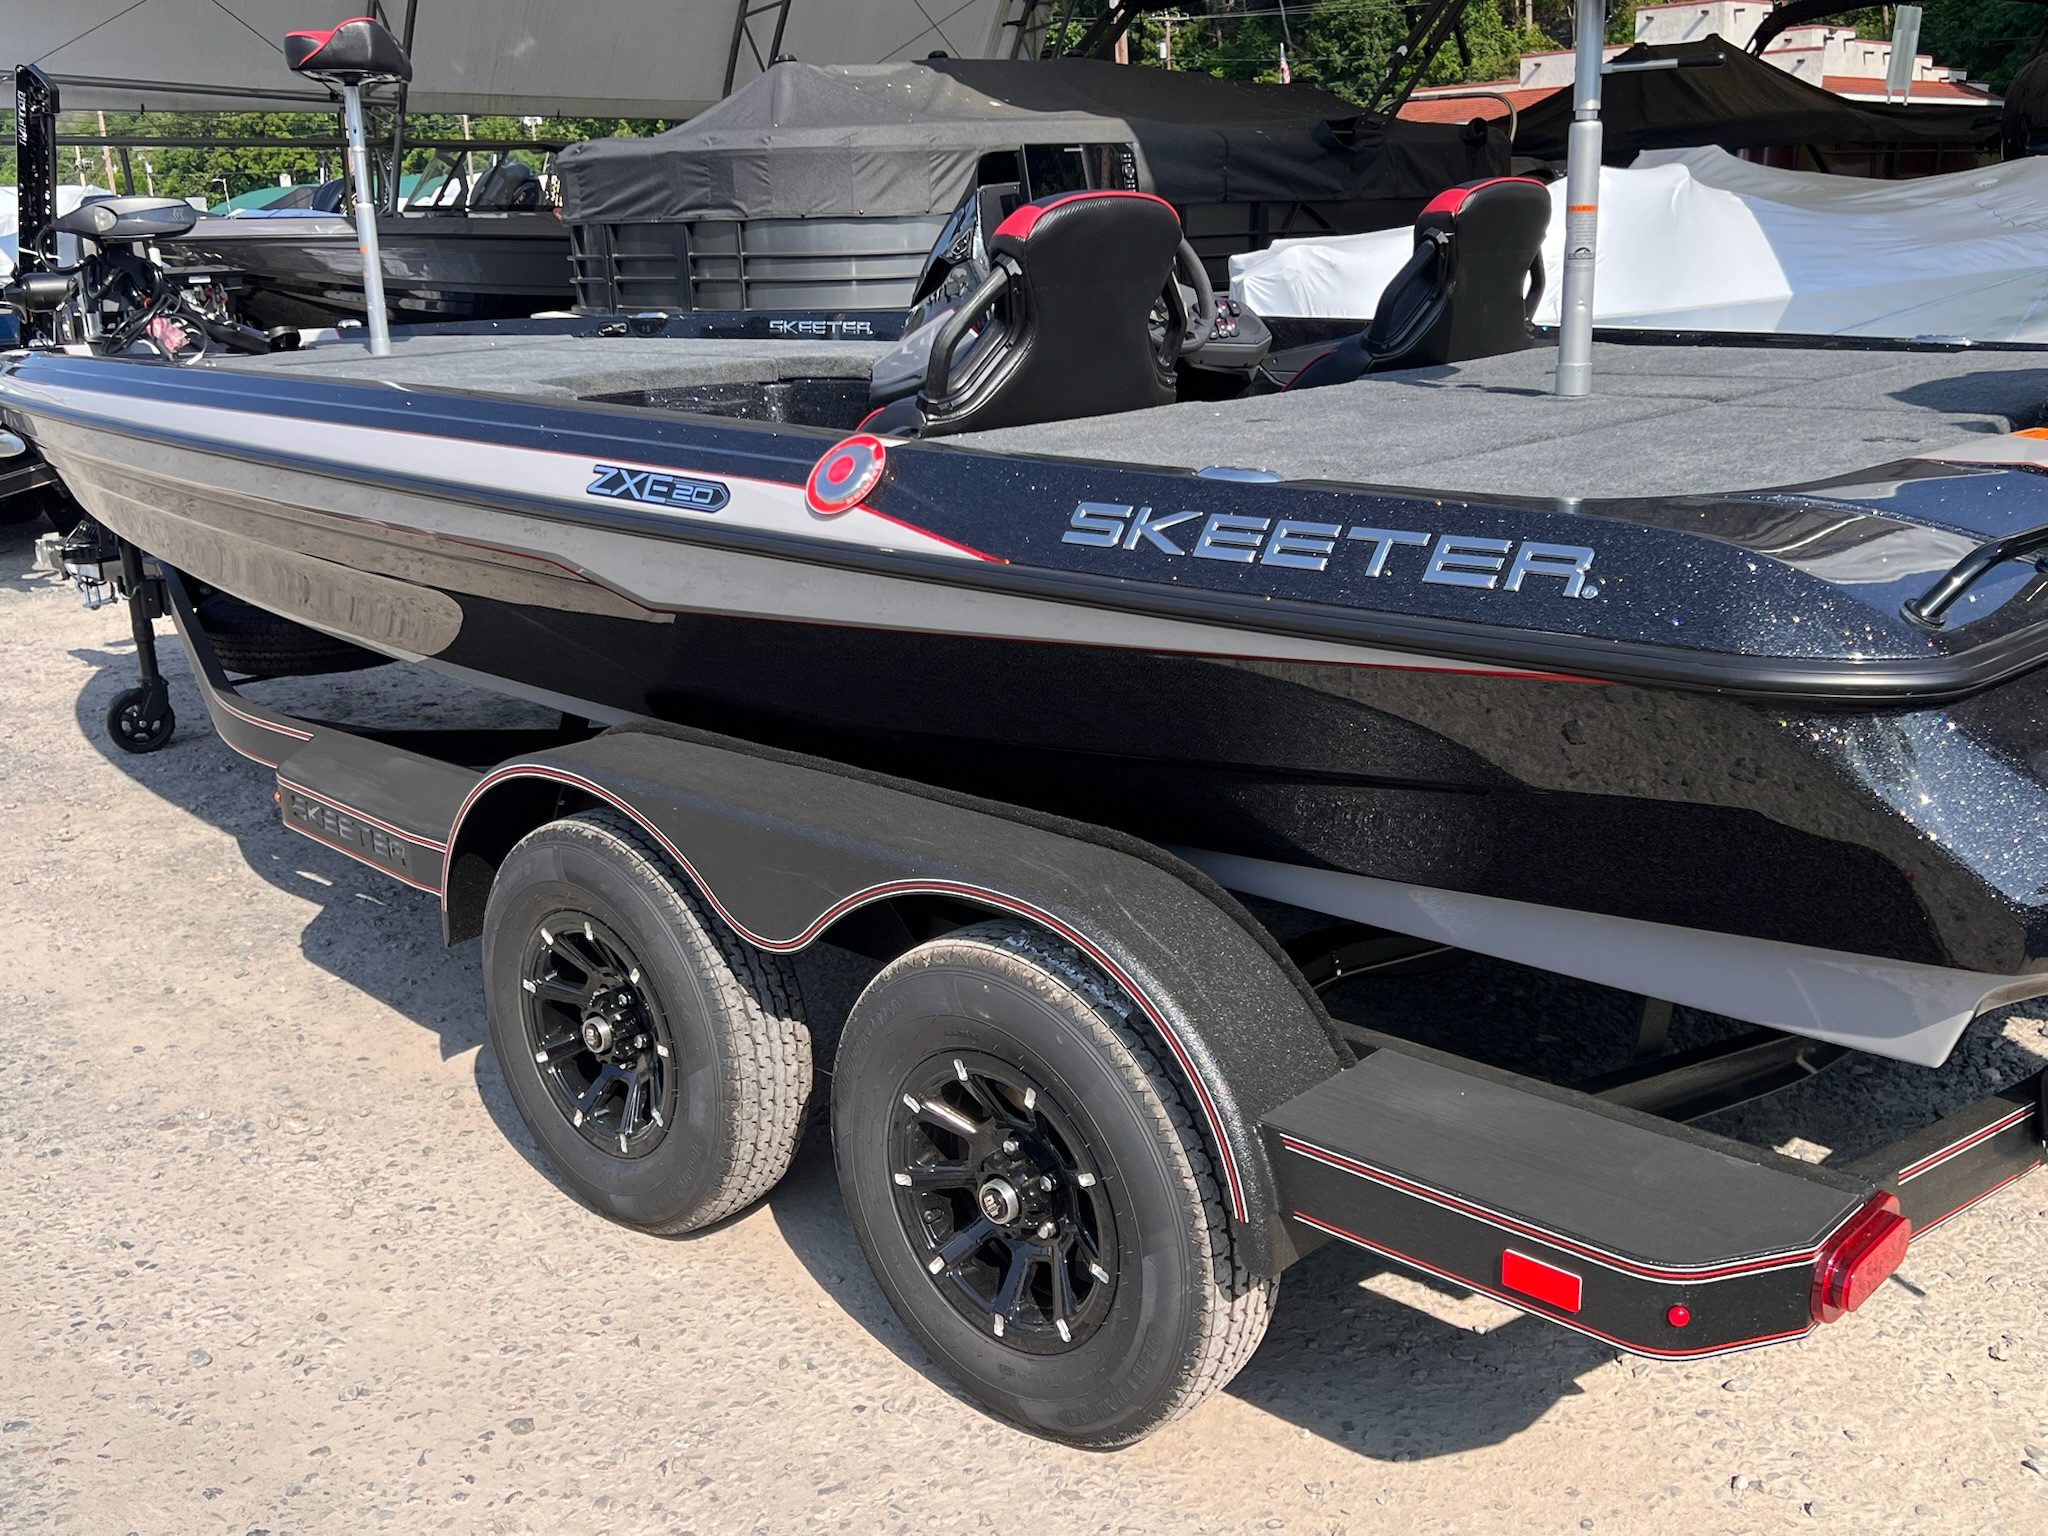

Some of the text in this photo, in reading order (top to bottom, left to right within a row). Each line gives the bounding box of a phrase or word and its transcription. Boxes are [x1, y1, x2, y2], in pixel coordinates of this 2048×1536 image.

[769, 319, 871, 335] SKEETER
[1060, 501, 1597, 600] SKEETER
[290, 795, 407, 869] SKEETER
